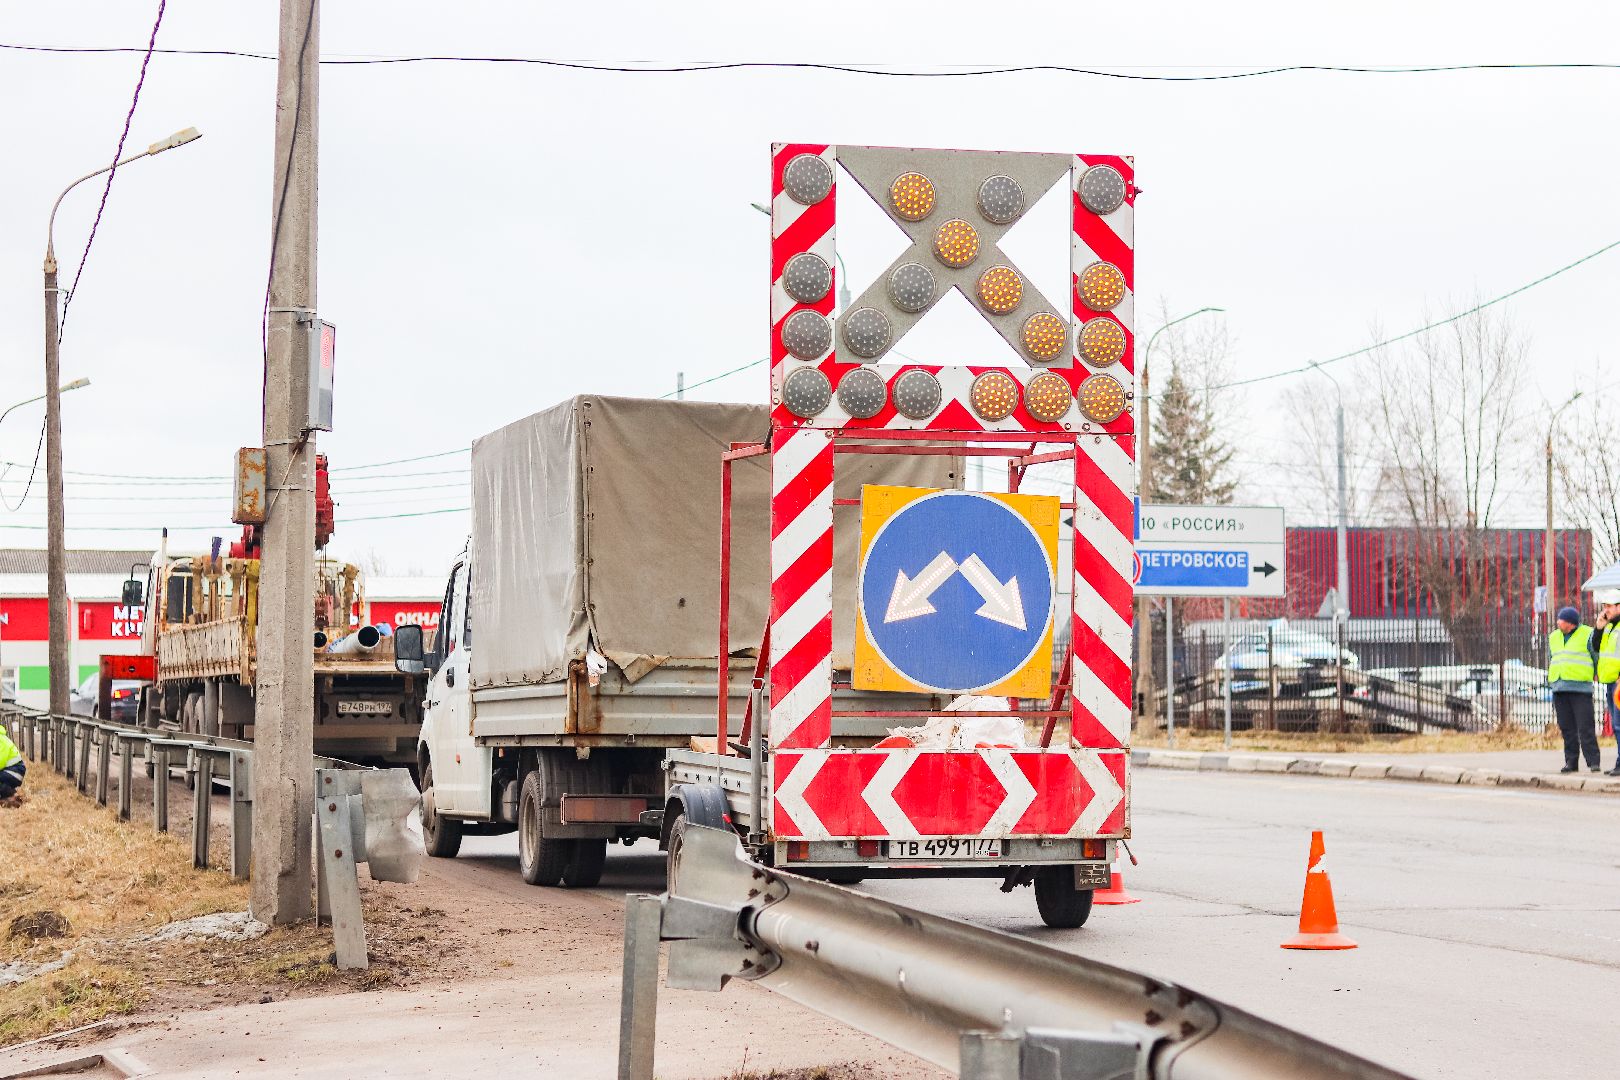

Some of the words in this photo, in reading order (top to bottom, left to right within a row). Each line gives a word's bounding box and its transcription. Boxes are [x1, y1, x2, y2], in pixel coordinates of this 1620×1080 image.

[1162, 517, 1245, 532] «РОССИЯ»
[1140, 552, 1247, 568] ПЕТРОВСКОЕ
[897, 841, 919, 856] ТВ
[924, 838, 972, 856] 4991
